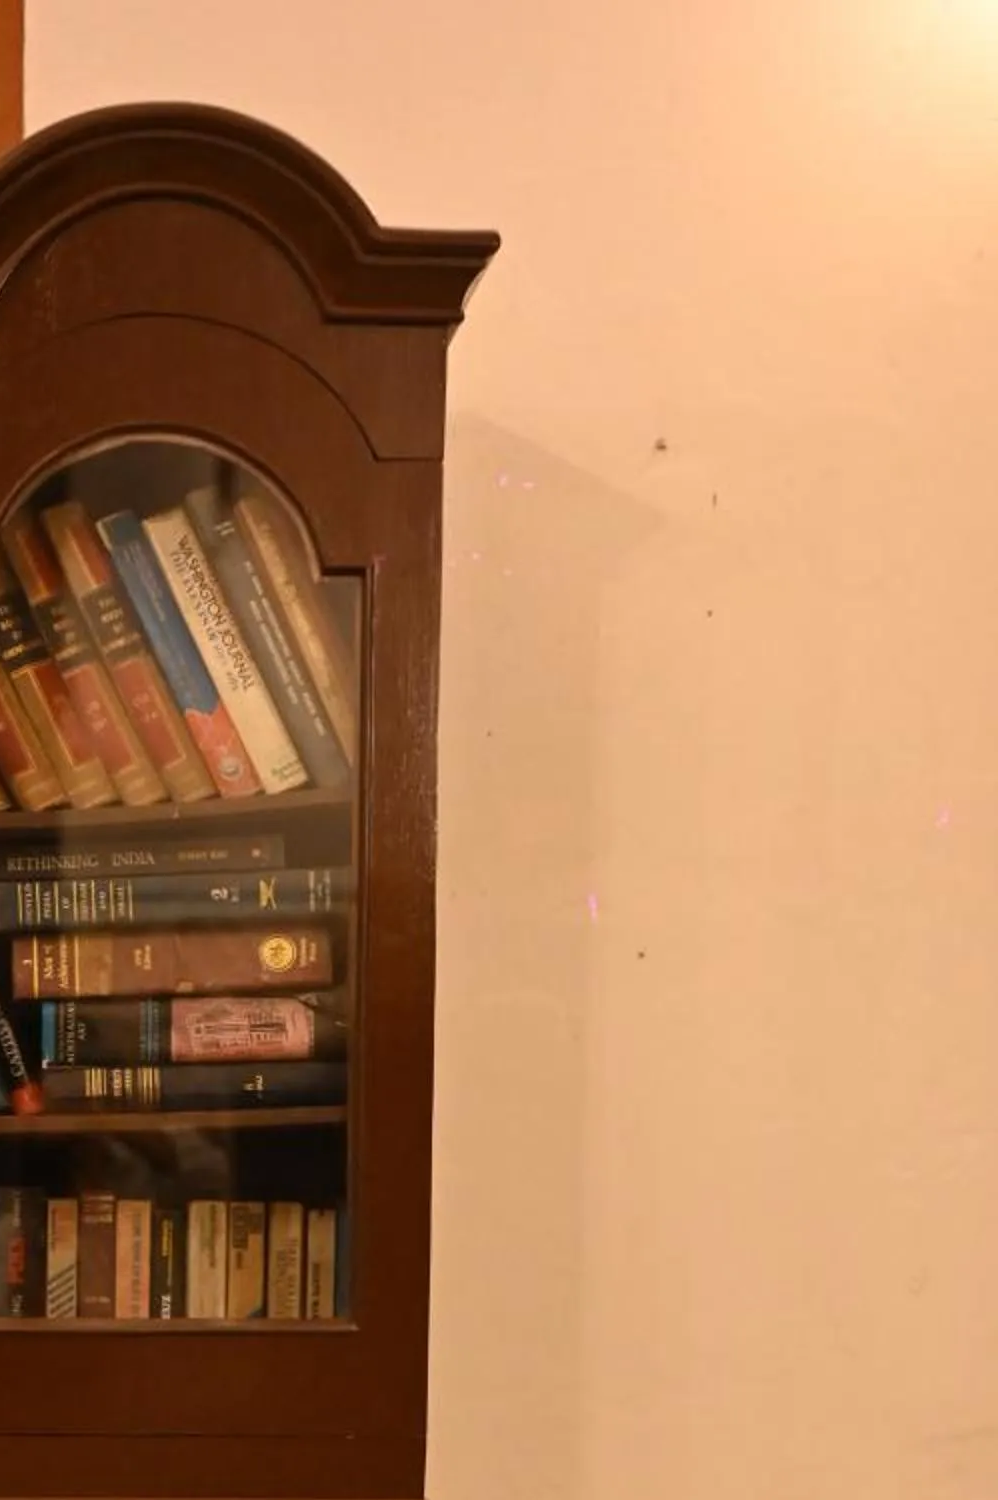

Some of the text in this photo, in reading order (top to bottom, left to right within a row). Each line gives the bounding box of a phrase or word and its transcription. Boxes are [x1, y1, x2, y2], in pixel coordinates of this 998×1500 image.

[178, 534, 226, 628] WASHINGTON
[218, 628, 255, 692] JOURNAL
[112, 852, 155, 866] INDIA
